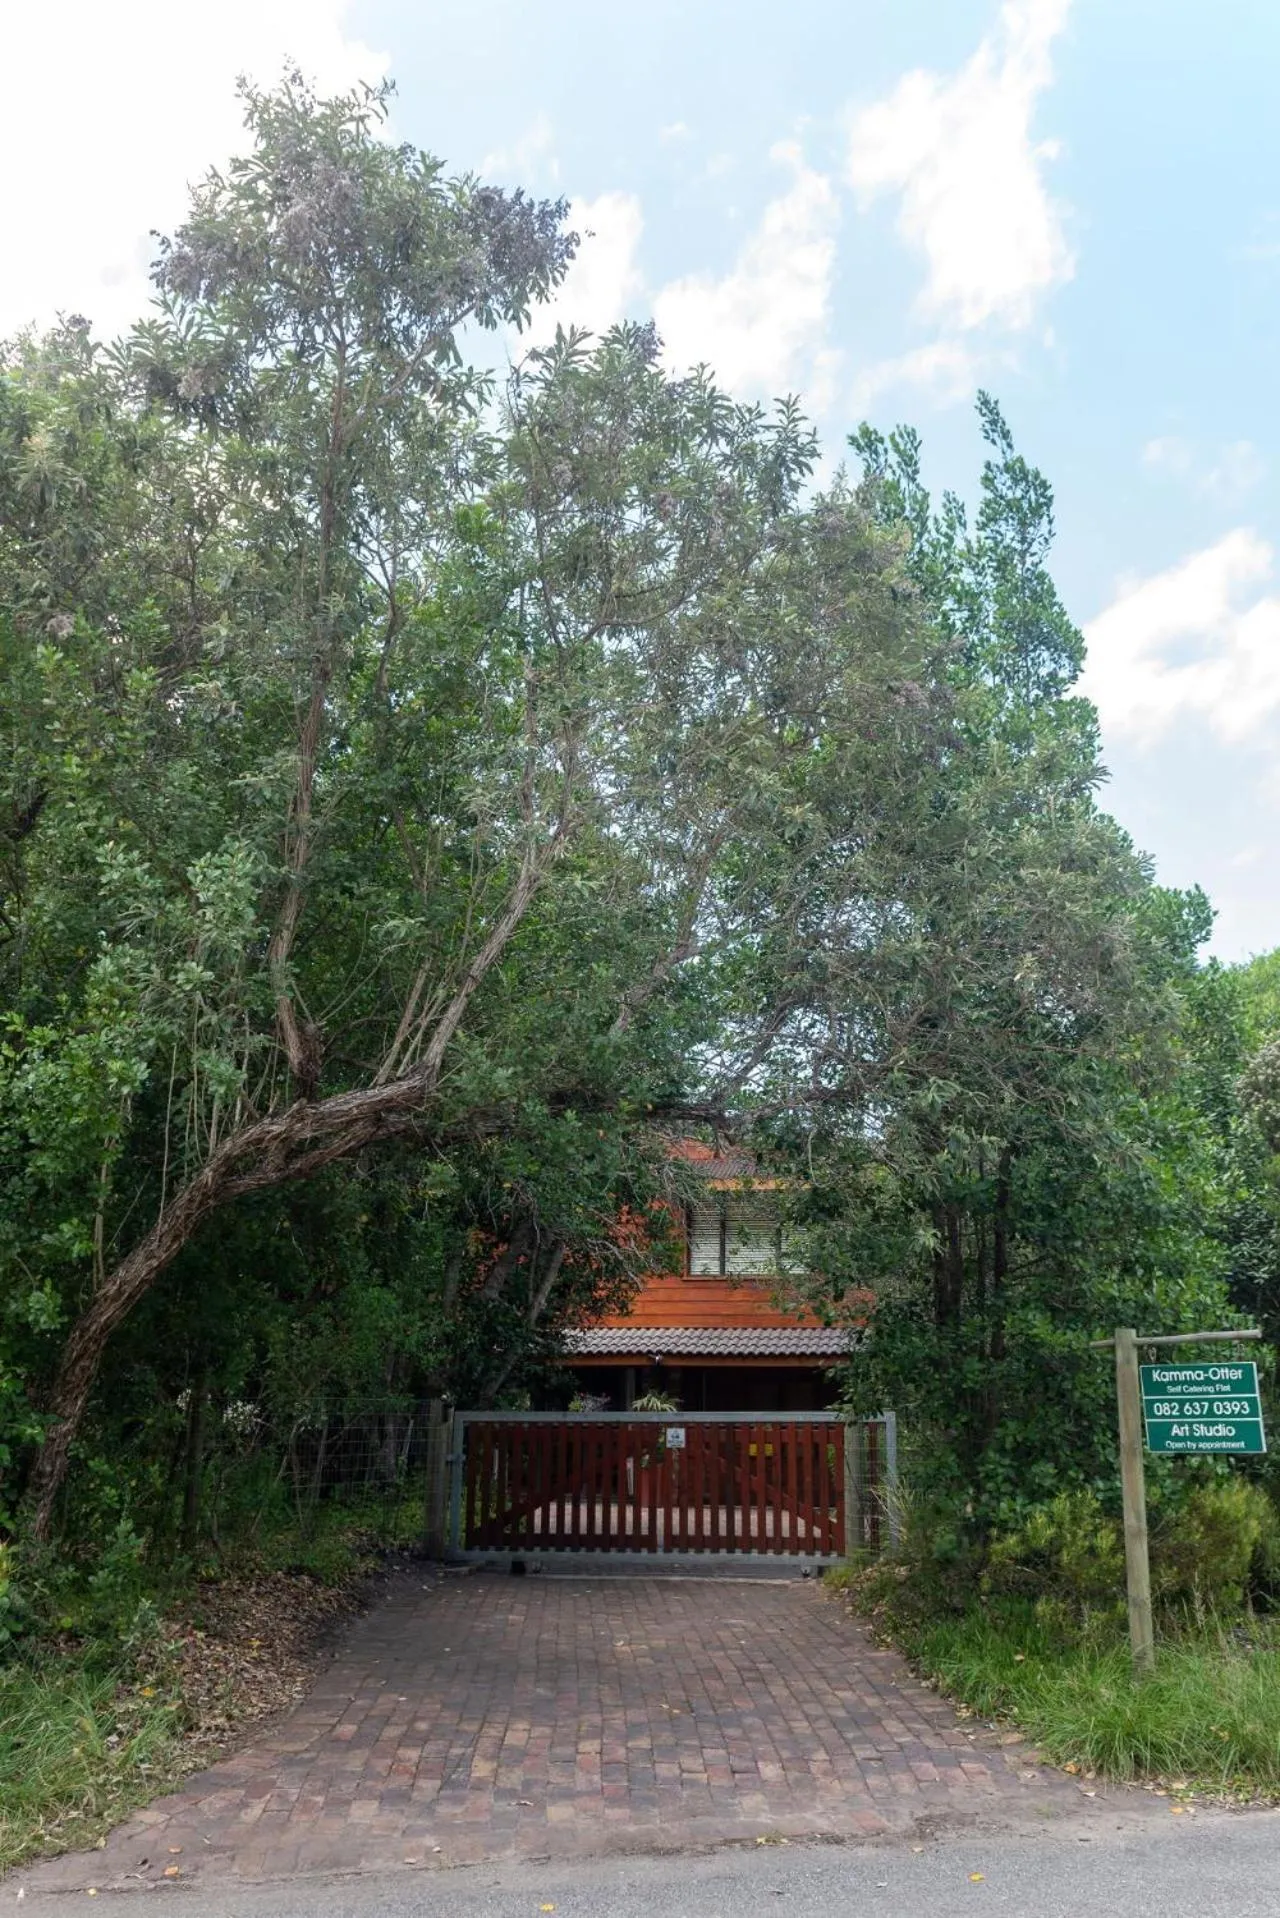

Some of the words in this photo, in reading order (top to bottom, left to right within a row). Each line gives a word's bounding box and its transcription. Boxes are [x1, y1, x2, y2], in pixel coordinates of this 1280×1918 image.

[1152, 1367, 1243, 1381] Kamma-Otter
[1166, 1385, 1181, 1393] Self
[1183, 1385, 1214, 1393] Catering
[1216, 1384, 1231, 1392] Flat
[1153, 1402, 1180, 1416] 082
[1183, 1402, 1209, 1415] 637
[1213, 1401, 1250, 1415] 0393
[1171, 1424, 1189, 1437] Art
[1192, 1423, 1236, 1437] Studio
[1165, 1441, 1186, 1449] Open
[1187, 1441, 1196, 1449] by
[1198, 1441, 1245, 1449] appointment
